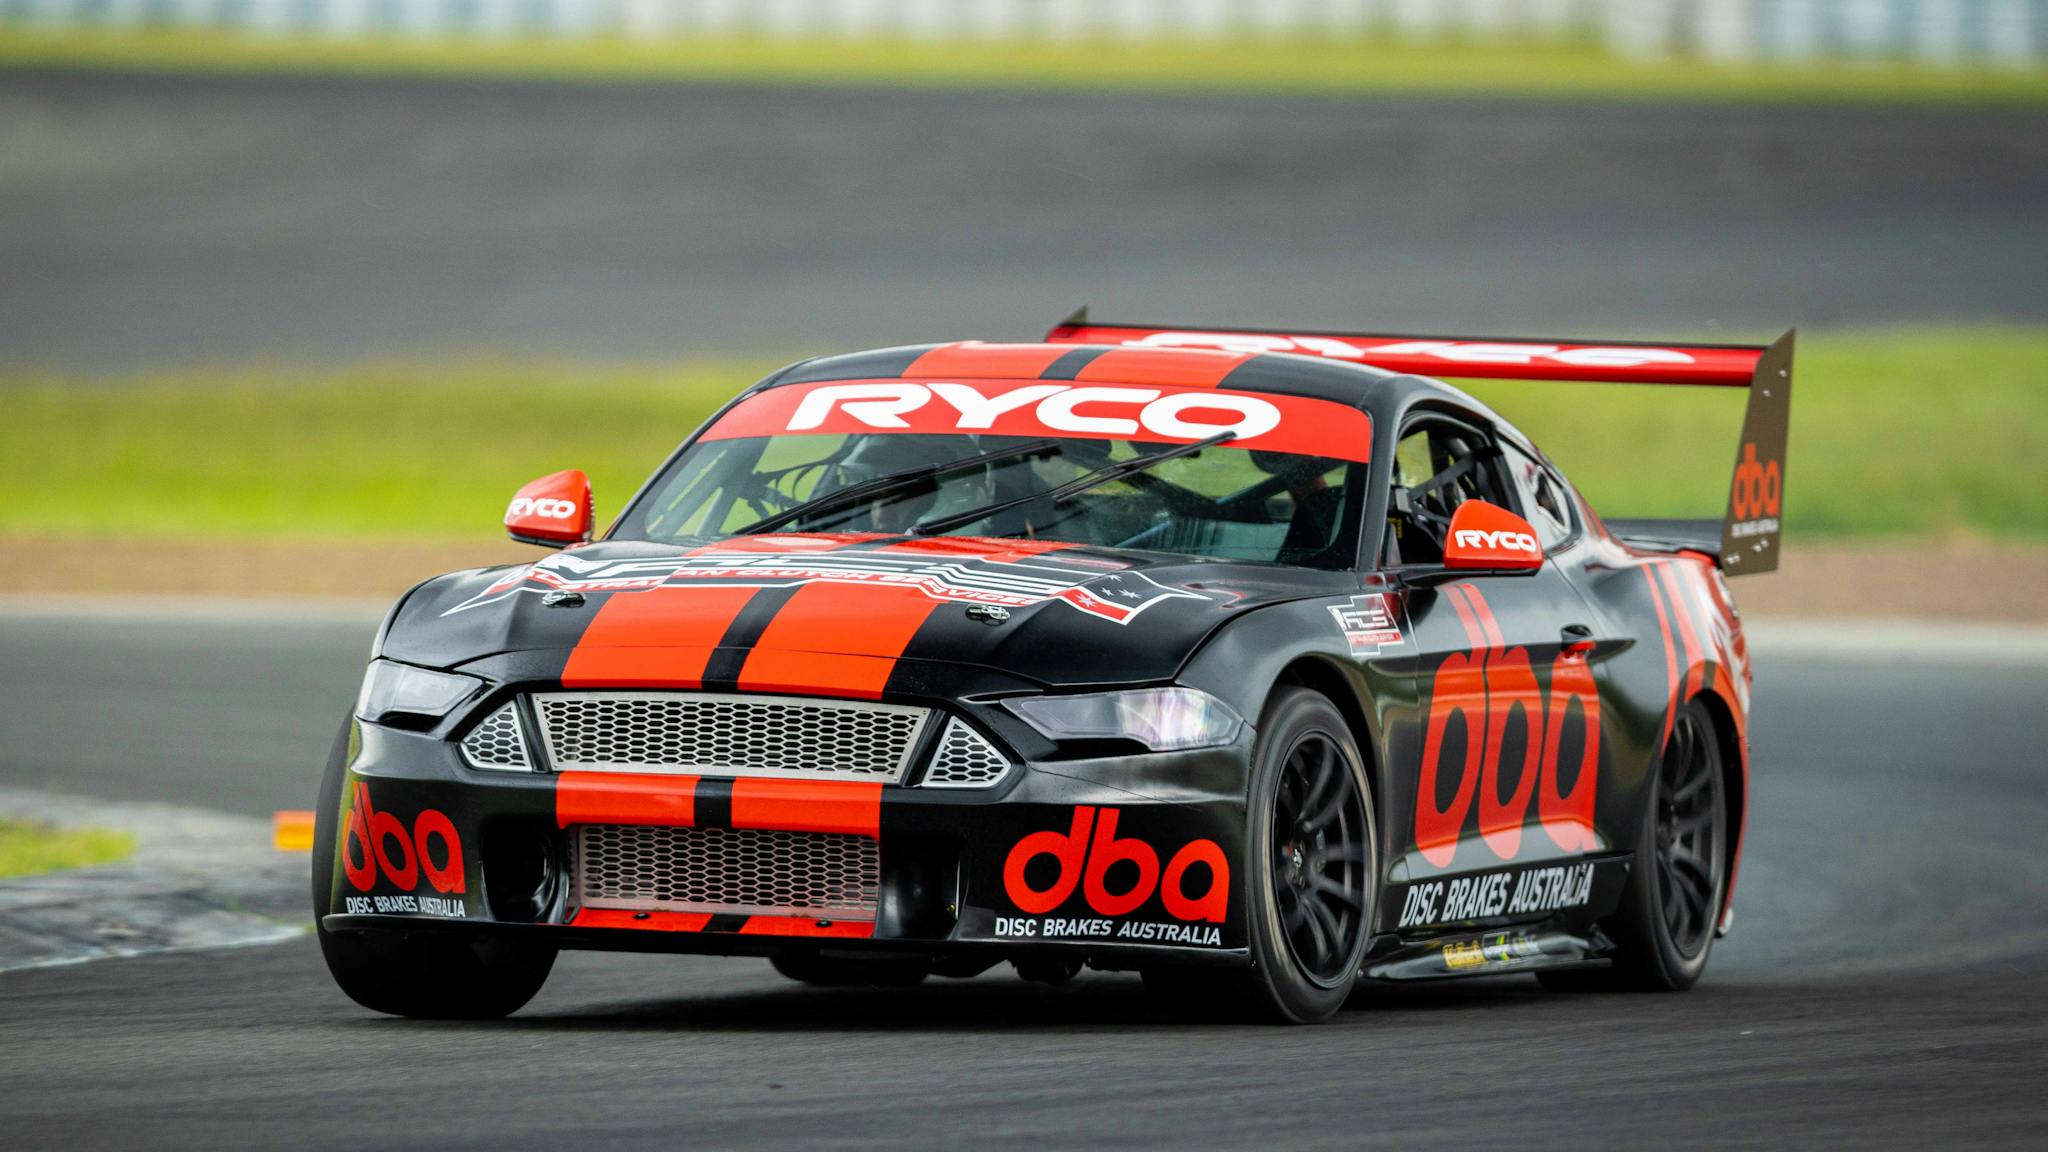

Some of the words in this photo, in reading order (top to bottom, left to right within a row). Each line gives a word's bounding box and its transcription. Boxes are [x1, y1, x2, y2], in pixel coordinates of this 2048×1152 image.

[786, 382, 1281, 440] RYCO
[1454, 529, 1537, 553] RYCO
[735, 568, 874, 581] CLUTCH
[1414, 583, 1602, 868] dba
[342, 781, 466, 894] dba
[1003, 805, 1230, 923] dba
[345, 896, 374, 914] DISC
[374, 896, 418, 913] BRAKES
[418, 896, 466, 918] AUSTRALIA
[1398, 881, 1443, 928] DISC
[1441, 872, 1512, 922] BRAKES
[1507, 863, 1595, 915] AUSTRALIA
[995, 917, 1036, 937] DISC
[1042, 918, 1113, 937] BRAKES
[1117, 920, 1221, 946] AUSTRALIA
